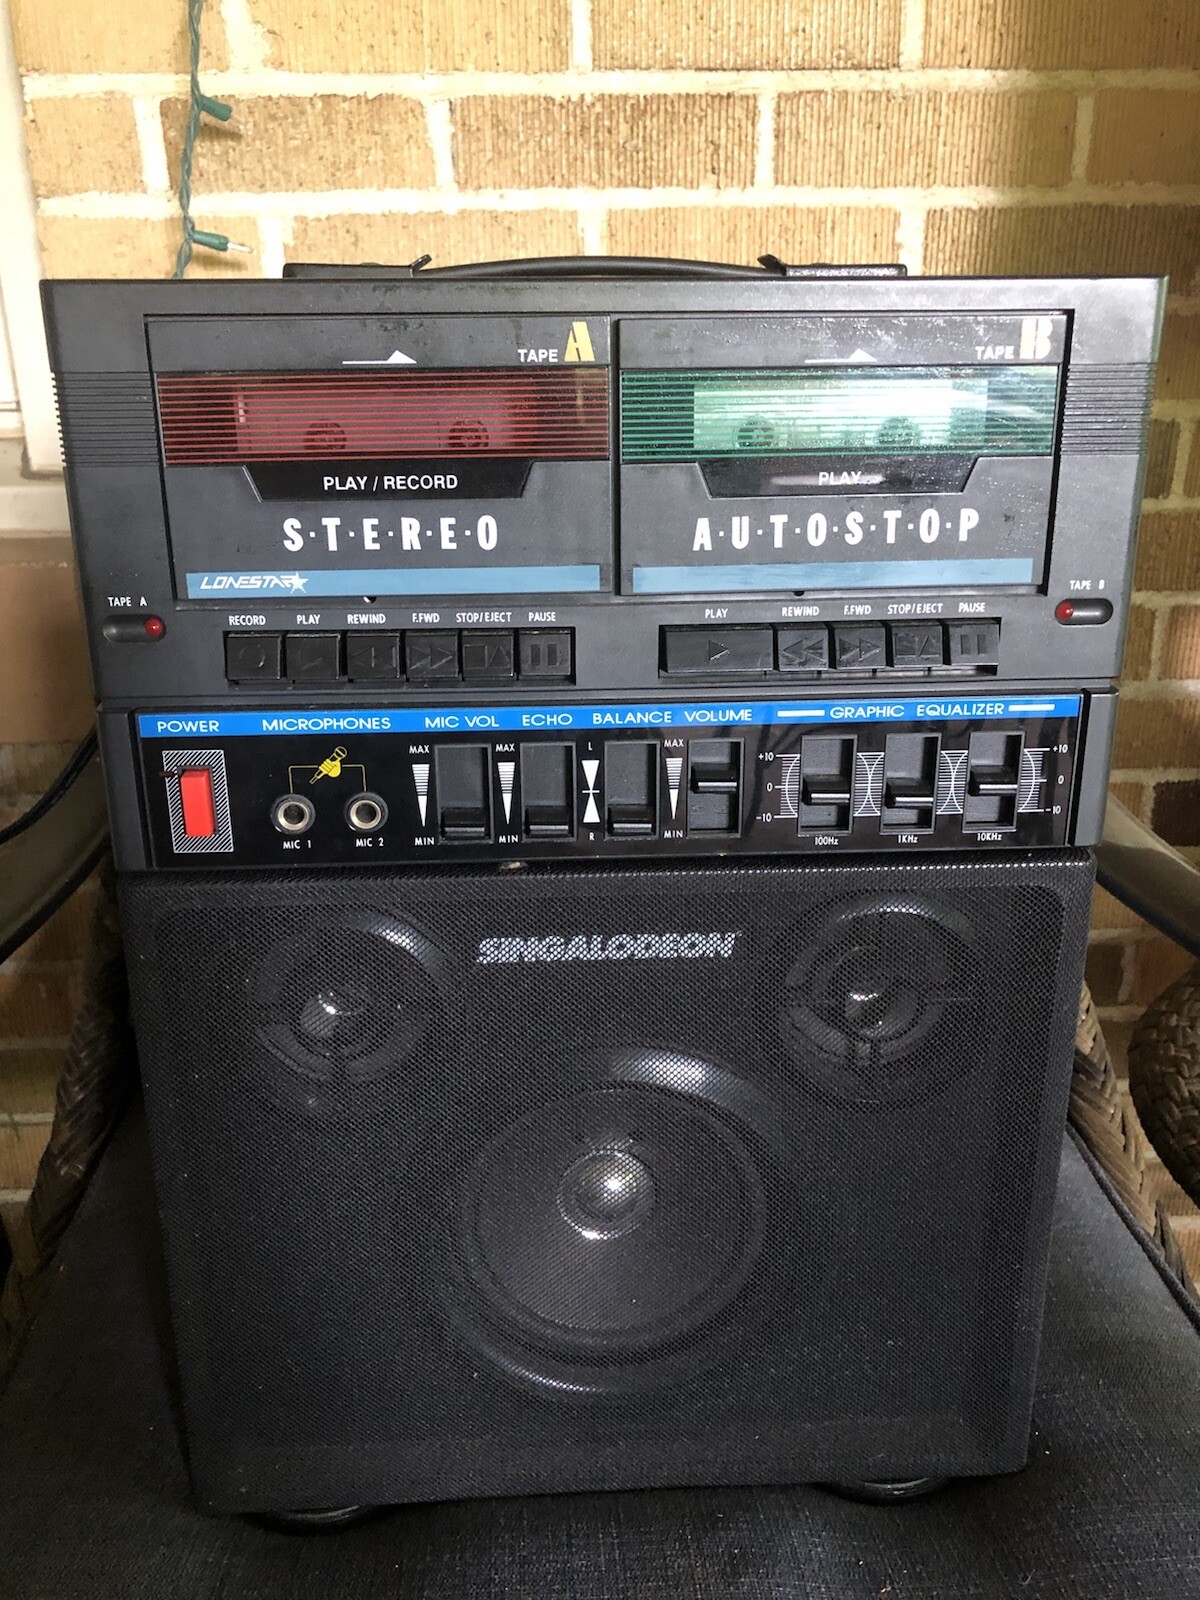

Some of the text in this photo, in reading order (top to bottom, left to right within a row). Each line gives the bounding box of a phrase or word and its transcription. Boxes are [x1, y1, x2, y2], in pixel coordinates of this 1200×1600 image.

[518, 321, 595, 363] TAPE A
[975, 318, 1053, 359] TAPE B
[323, 476, 368, 491] PLAY
[384, 474, 458, 490] RECORD
[818, 471, 862, 486] PLAY
[1069, 579, 1105, 590] TAPE B
[108, 596, 147, 607] TAPE A
[781, 605, 820, 617] REWIND
[844, 604, 872, 616] F.FWD
[887, 603, 943, 615] STOP/EJECT
[958, 602, 985, 613] PAUSE
[347, 613, 386, 625] REWIND
[412, 612, 440, 623] F.FWD
[456, 610, 512, 623] STOP/EJECT
[528, 610, 556, 622] PAUSE
[705, 608, 728, 619] PLAY
[229, 614, 266, 626] RECORD
[296, 614, 321, 625] PLAY
[685, 708, 752, 722] VOLUME
[829, 702, 1004, 719] GRAPHIC EQUALIZER
[425, 715, 499, 727] MIC VOL
[522, 713, 572, 726] ECHO
[593, 711, 672, 724] BALANCE
[157, 720, 219, 733] POWER
[262, 718, 391, 731] MICROPHONES
[496, 743, 515, 752] MAX
[588, 742, 593, 751] L
[664, 739, 684, 748] MAX
[409, 745, 429, 754] MAX
[1052, 745, 1068, 754] +10
[758, 752, 774, 761] +10
[1058, 776, 1064, 784] 0
[767, 783, 773, 791] 0
[1045, 806, 1061, 815] -10
[756, 813, 772, 822] -10
[499, 834, 518, 843] MIN
[589, 832, 594, 841] R
[664, 830, 683, 838] MIN
[283, 839, 312, 849] MIC 1
[355, 837, 384, 847] MIC 2
[415, 837, 434, 845] MIN
[475, 931, 735, 964] SINGALODEON
